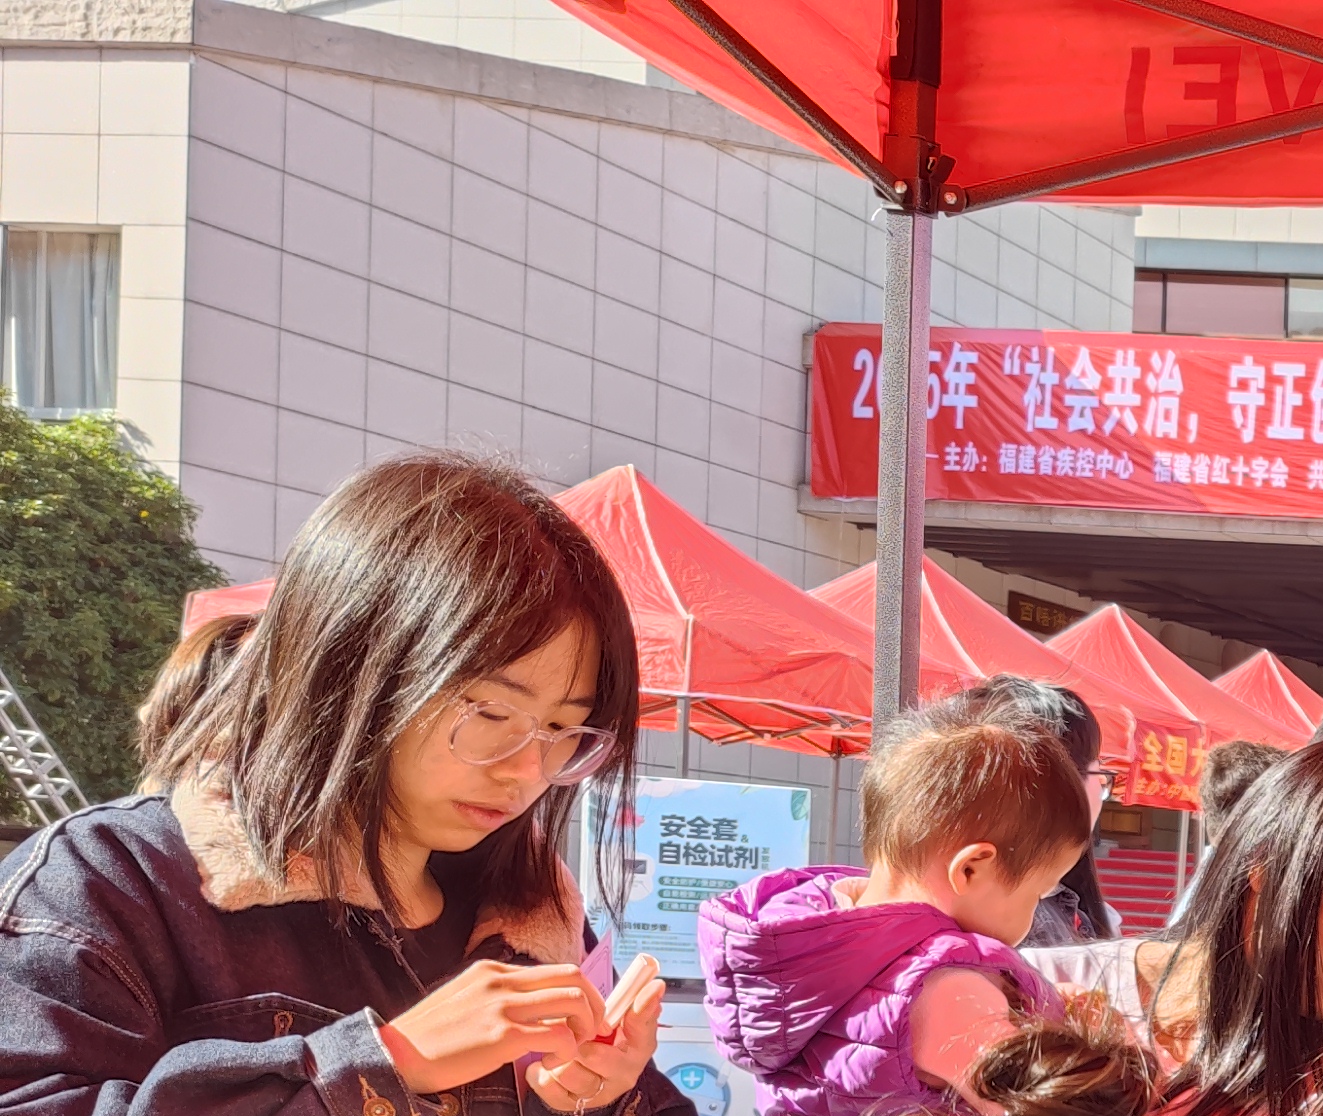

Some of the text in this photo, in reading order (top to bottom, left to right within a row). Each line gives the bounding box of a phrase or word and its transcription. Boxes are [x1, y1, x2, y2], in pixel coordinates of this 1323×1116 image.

[1154, 449, 1289, 489] 福建省红十字会
[660, 814, 738, 842] 安全套
[659, 841, 759, 870] 自检试剂
